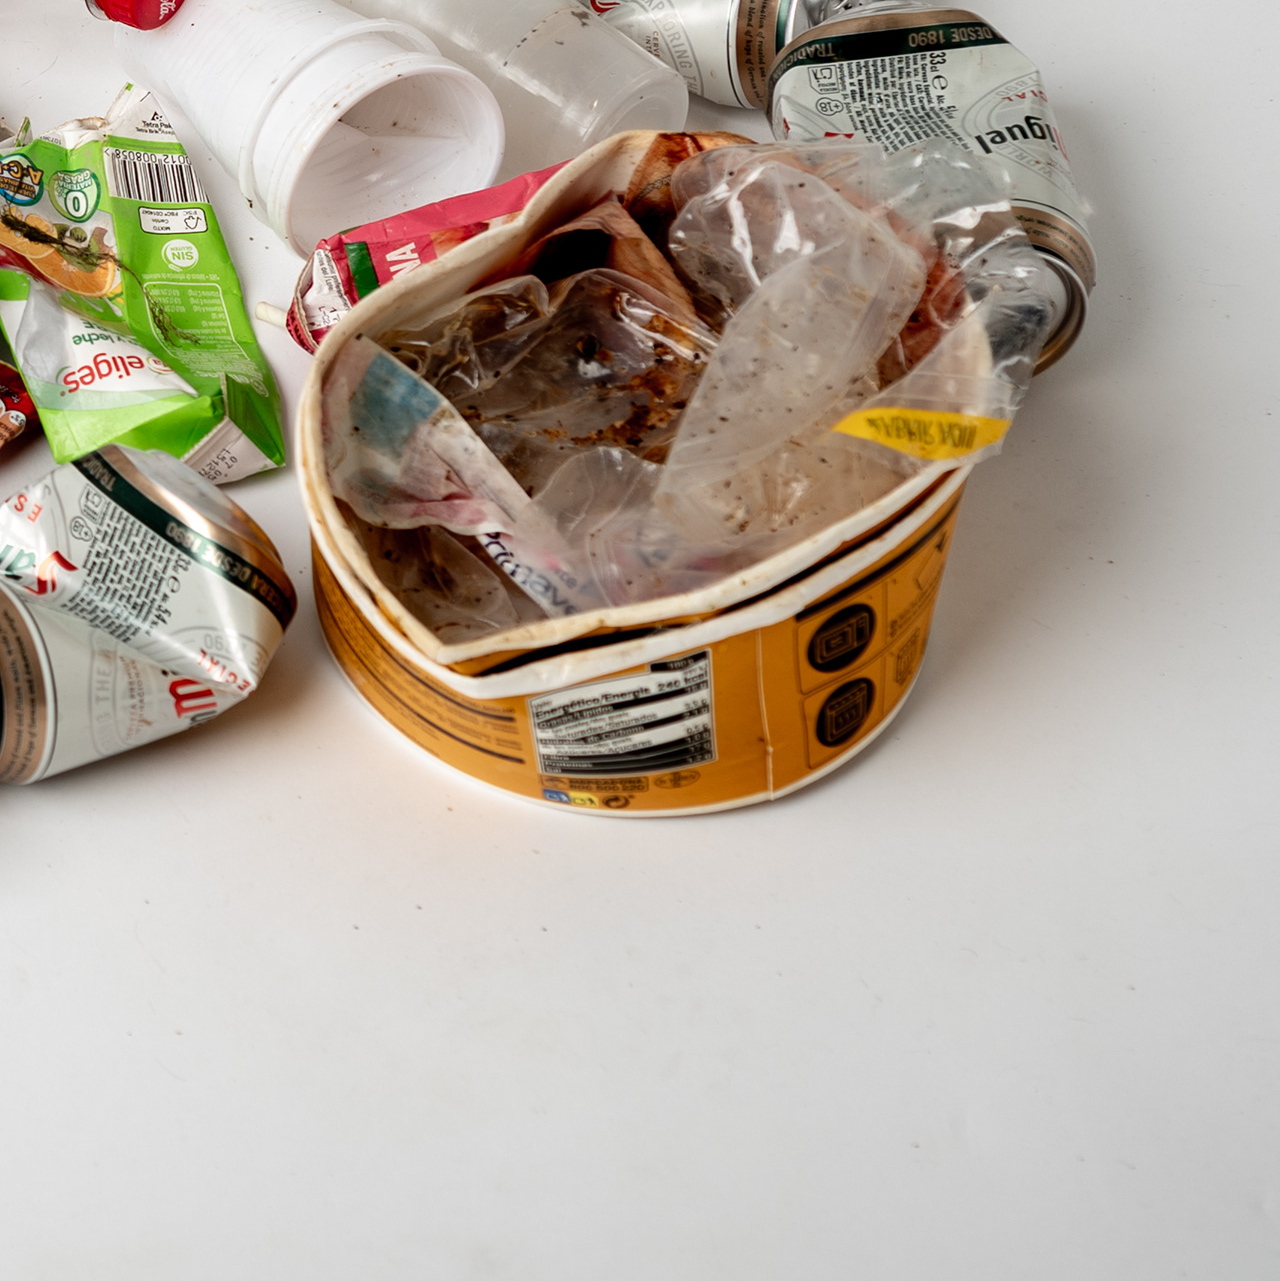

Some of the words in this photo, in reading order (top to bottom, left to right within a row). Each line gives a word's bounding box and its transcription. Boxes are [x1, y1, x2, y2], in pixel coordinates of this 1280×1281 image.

[908, 29, 946, 48] 1890
[816, 96, 845, 116] +18
[141, 120, 160, 129] Tetra
[171, 250, 195, 261] SIN
[72, 332, 116, 346] leche
[62, 352, 146, 396] eliges
